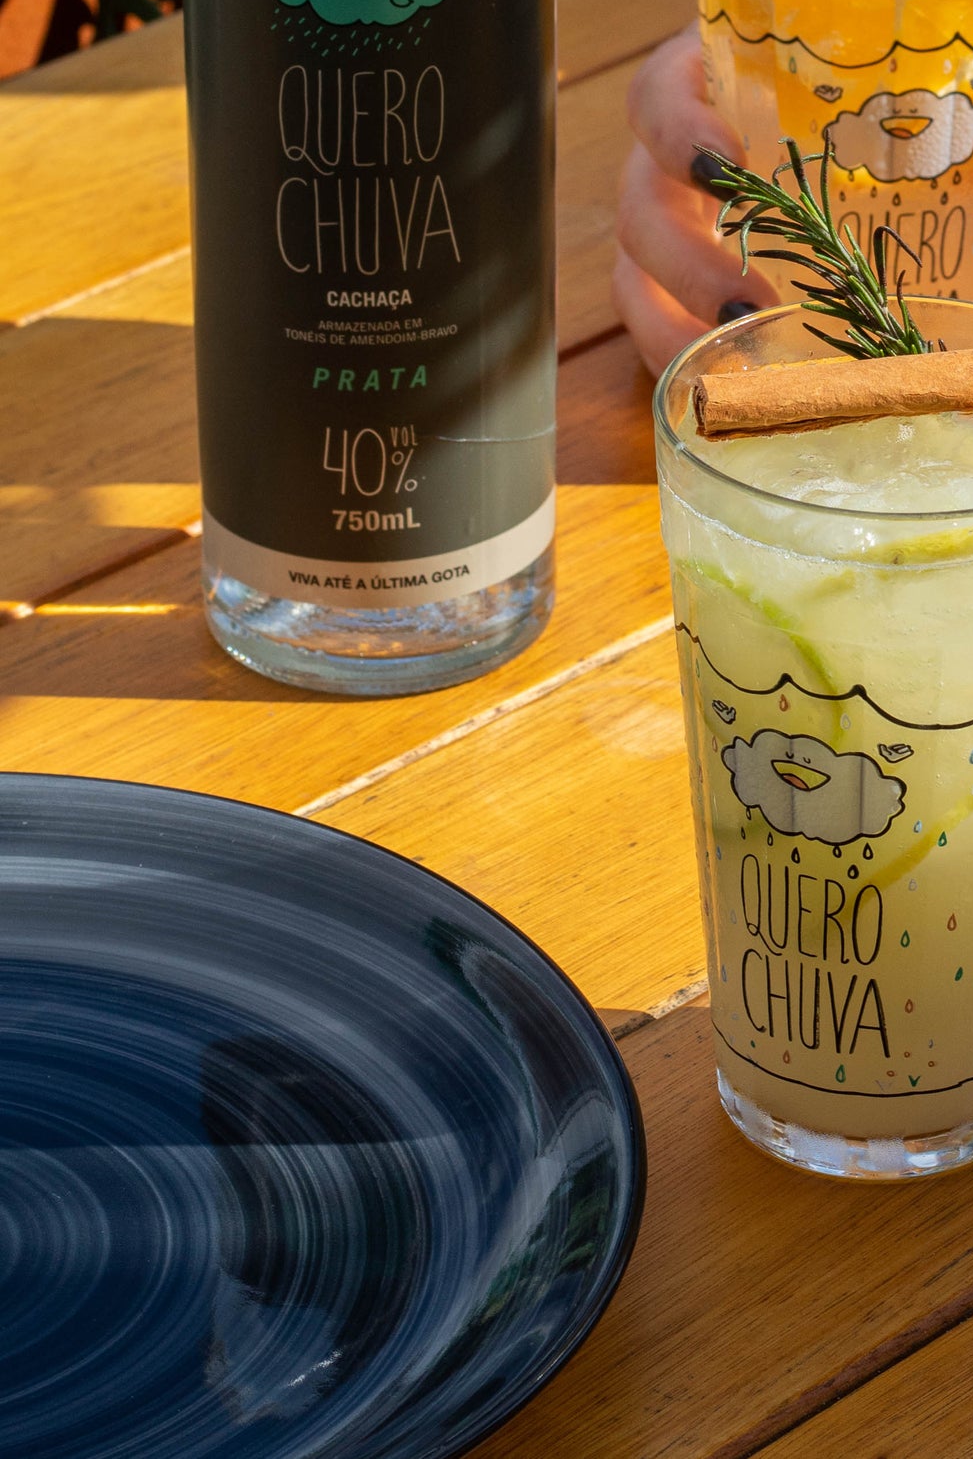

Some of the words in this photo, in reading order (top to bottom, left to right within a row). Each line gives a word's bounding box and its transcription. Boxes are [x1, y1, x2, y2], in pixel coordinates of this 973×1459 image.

[278, 64, 445, 175] QUERO
[276, 174, 461, 275] CHUVA
[326, 289, 413, 311] CACHAÇA
[284, 327, 327, 344] TONÉIS
[329, 334, 346, 345] DE
[318, 319, 400, 333] ARMAZENADA
[404, 317, 423, 329] EM
[312, 364, 427, 392] PRATA
[390, 424, 418, 448] VOL
[331, 506, 422, 532] 750mL
[288, 569, 321, 588] VIVA
[323, 574, 351, 590] ATÉ
[354, 577, 367, 590] A
[370, 573, 428, 590] ÚLTIMA
[431, 563, 471, 585] GOTA
[740, 853, 884, 966] QUERO
[740, 947, 891, 1059] CHUVA
